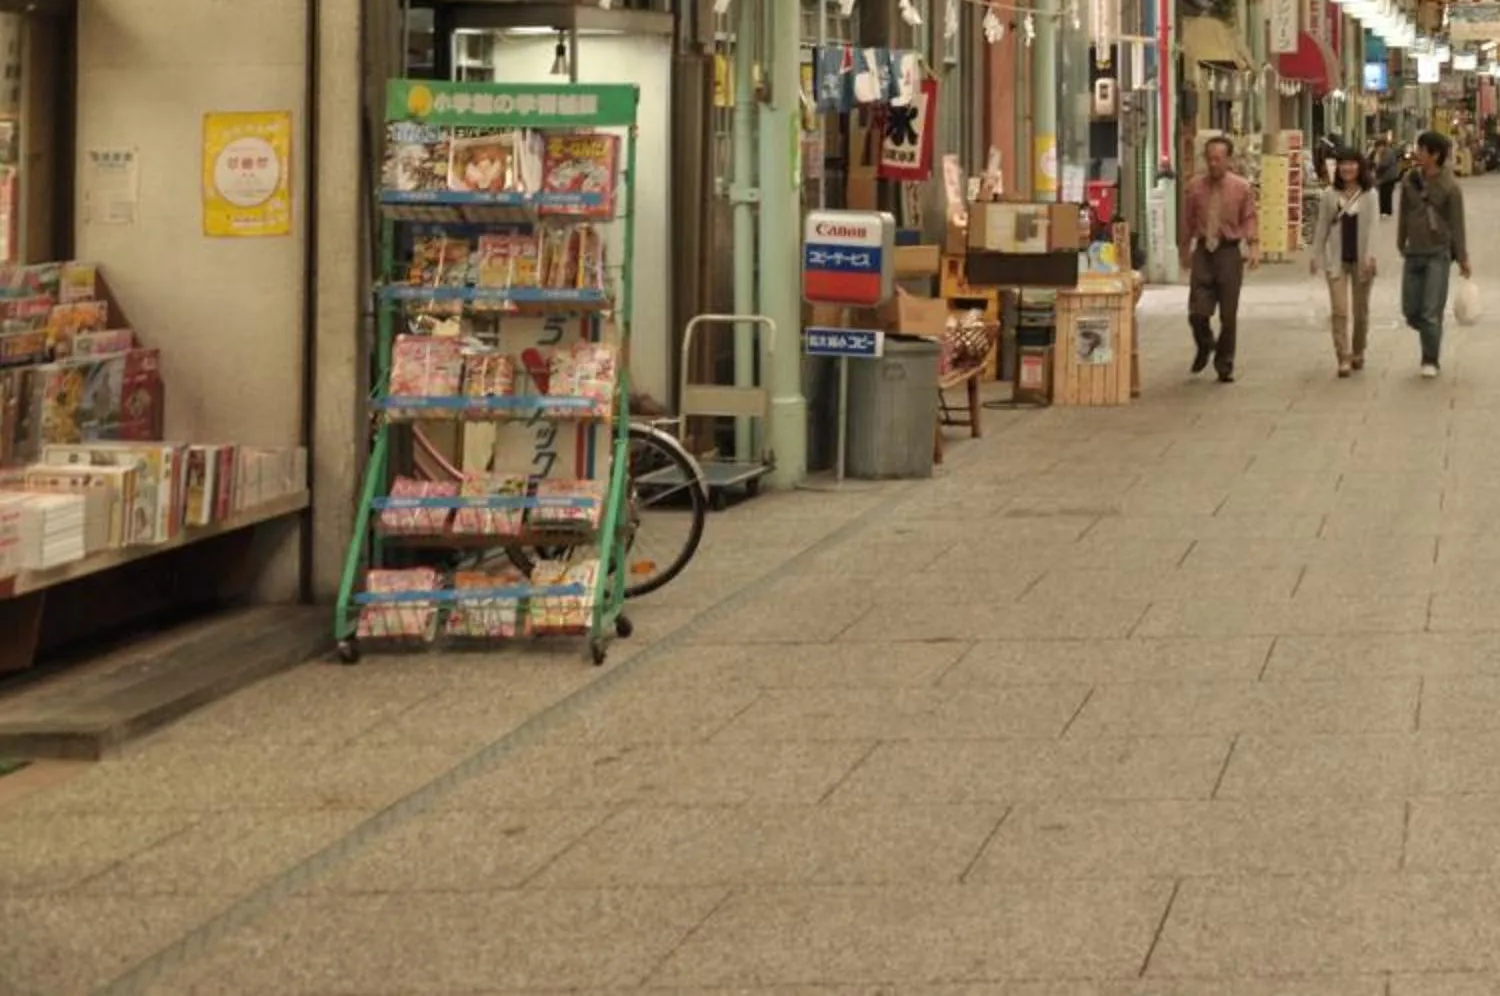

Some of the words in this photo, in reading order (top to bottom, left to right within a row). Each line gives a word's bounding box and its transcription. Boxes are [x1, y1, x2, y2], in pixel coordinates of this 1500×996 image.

[809, 250, 872, 267] コピーサービス
